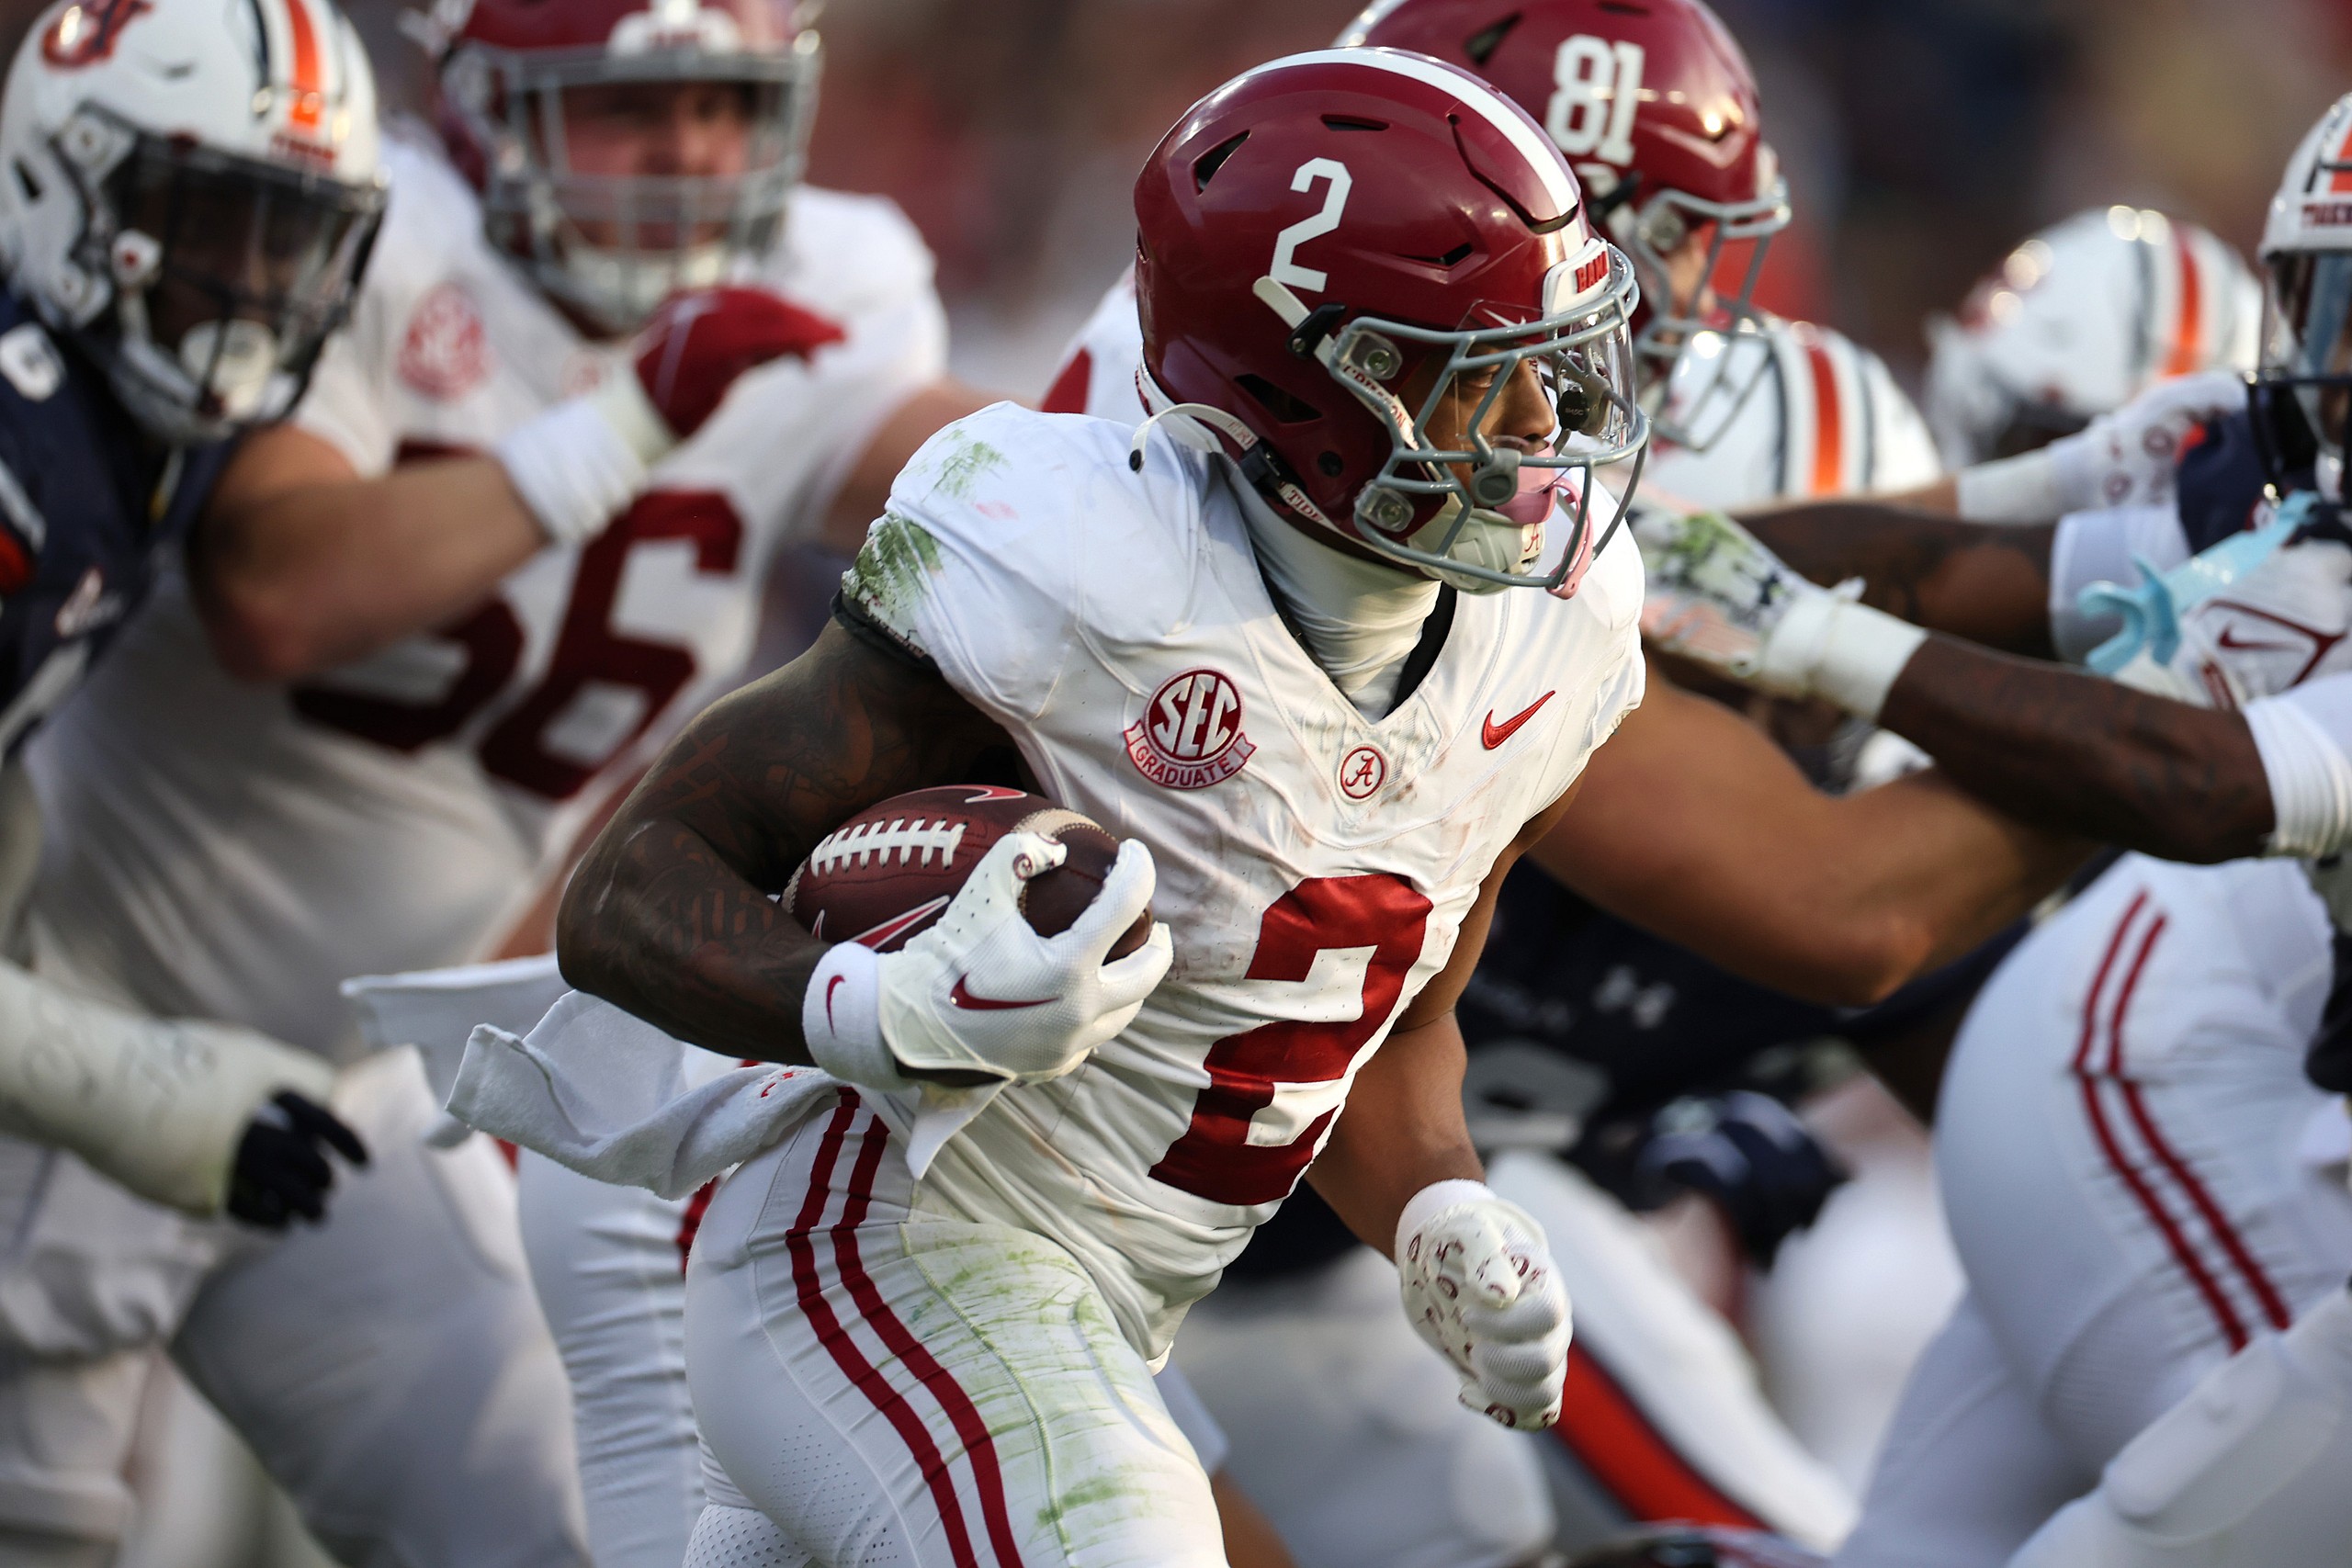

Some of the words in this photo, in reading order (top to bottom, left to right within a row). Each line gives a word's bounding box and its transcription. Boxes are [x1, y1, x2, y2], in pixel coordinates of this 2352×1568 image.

[1546, 34, 1644, 166] 81
[1270, 157, 1352, 293] 2
[1286, 489, 1324, 522] TIDE
[1153, 673, 1238, 757] SEC
[1136, 745, 1234, 786] GRADUATE
[1345, 754, 1375, 787] A
[1148, 874, 1434, 1206] 2
